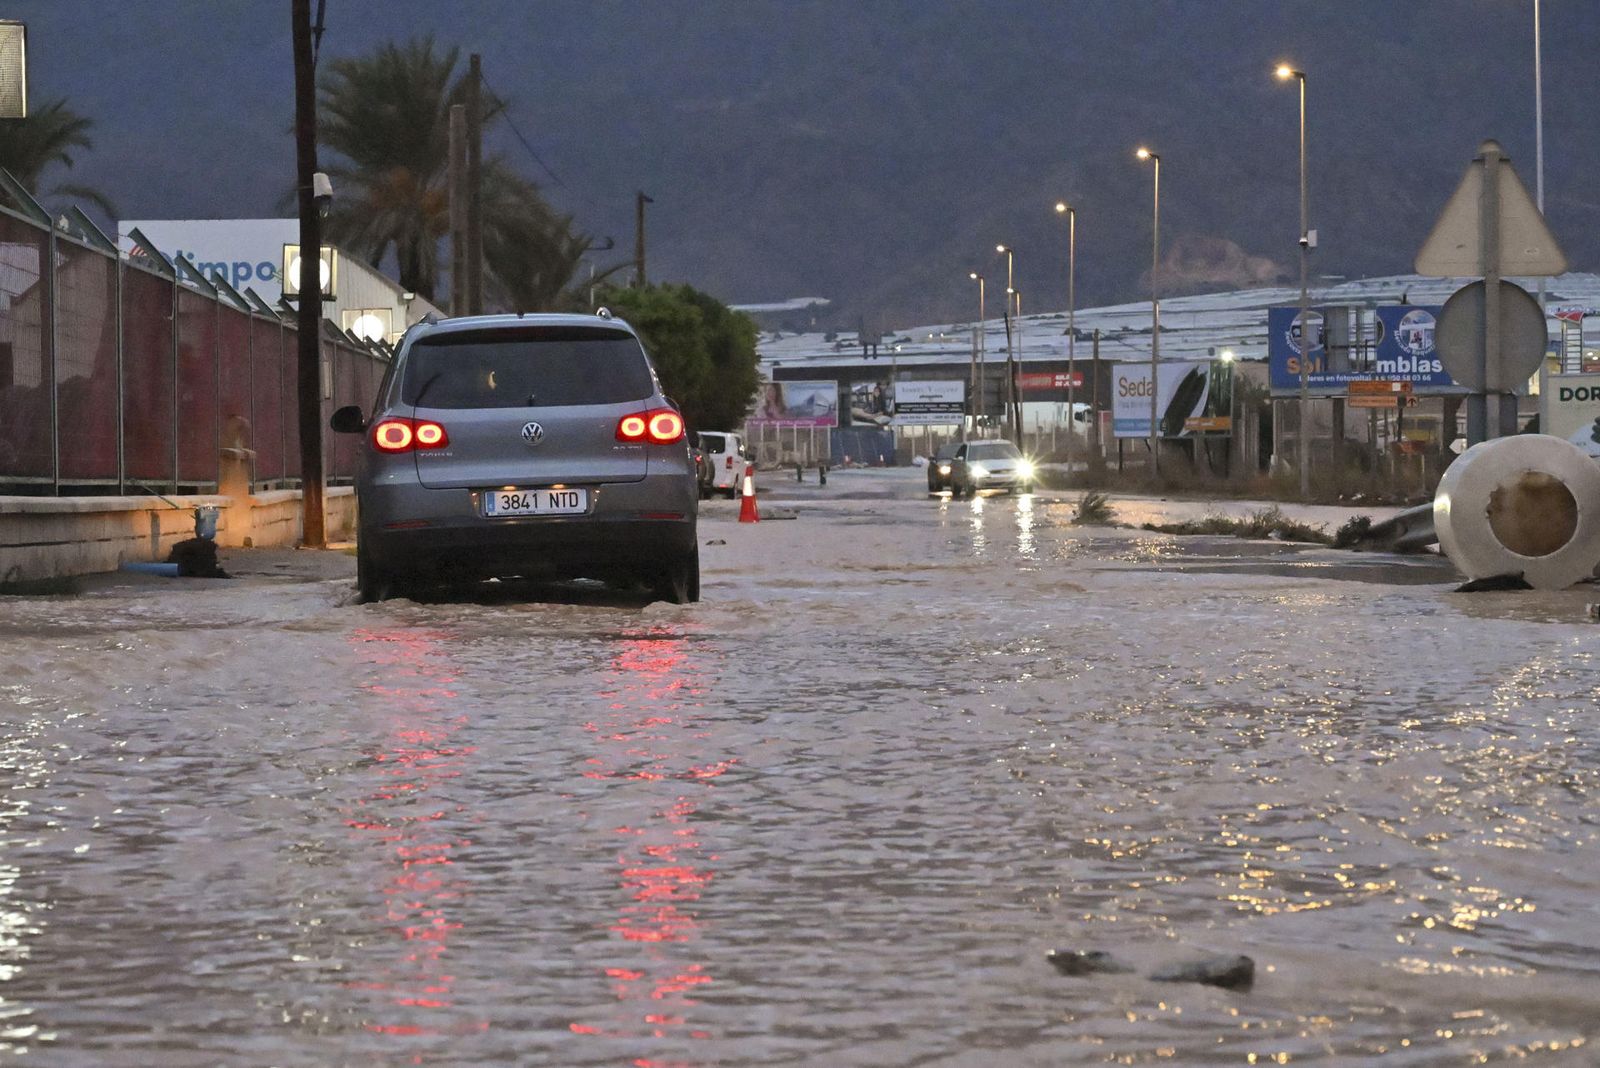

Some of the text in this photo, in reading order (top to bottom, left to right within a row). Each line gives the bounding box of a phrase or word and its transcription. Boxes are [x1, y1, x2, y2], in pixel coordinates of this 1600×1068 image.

[1376, 355, 1443, 373] mblas
[1118, 376, 1153, 397] Seda
[501, 491, 579, 510] 3841 NTD
